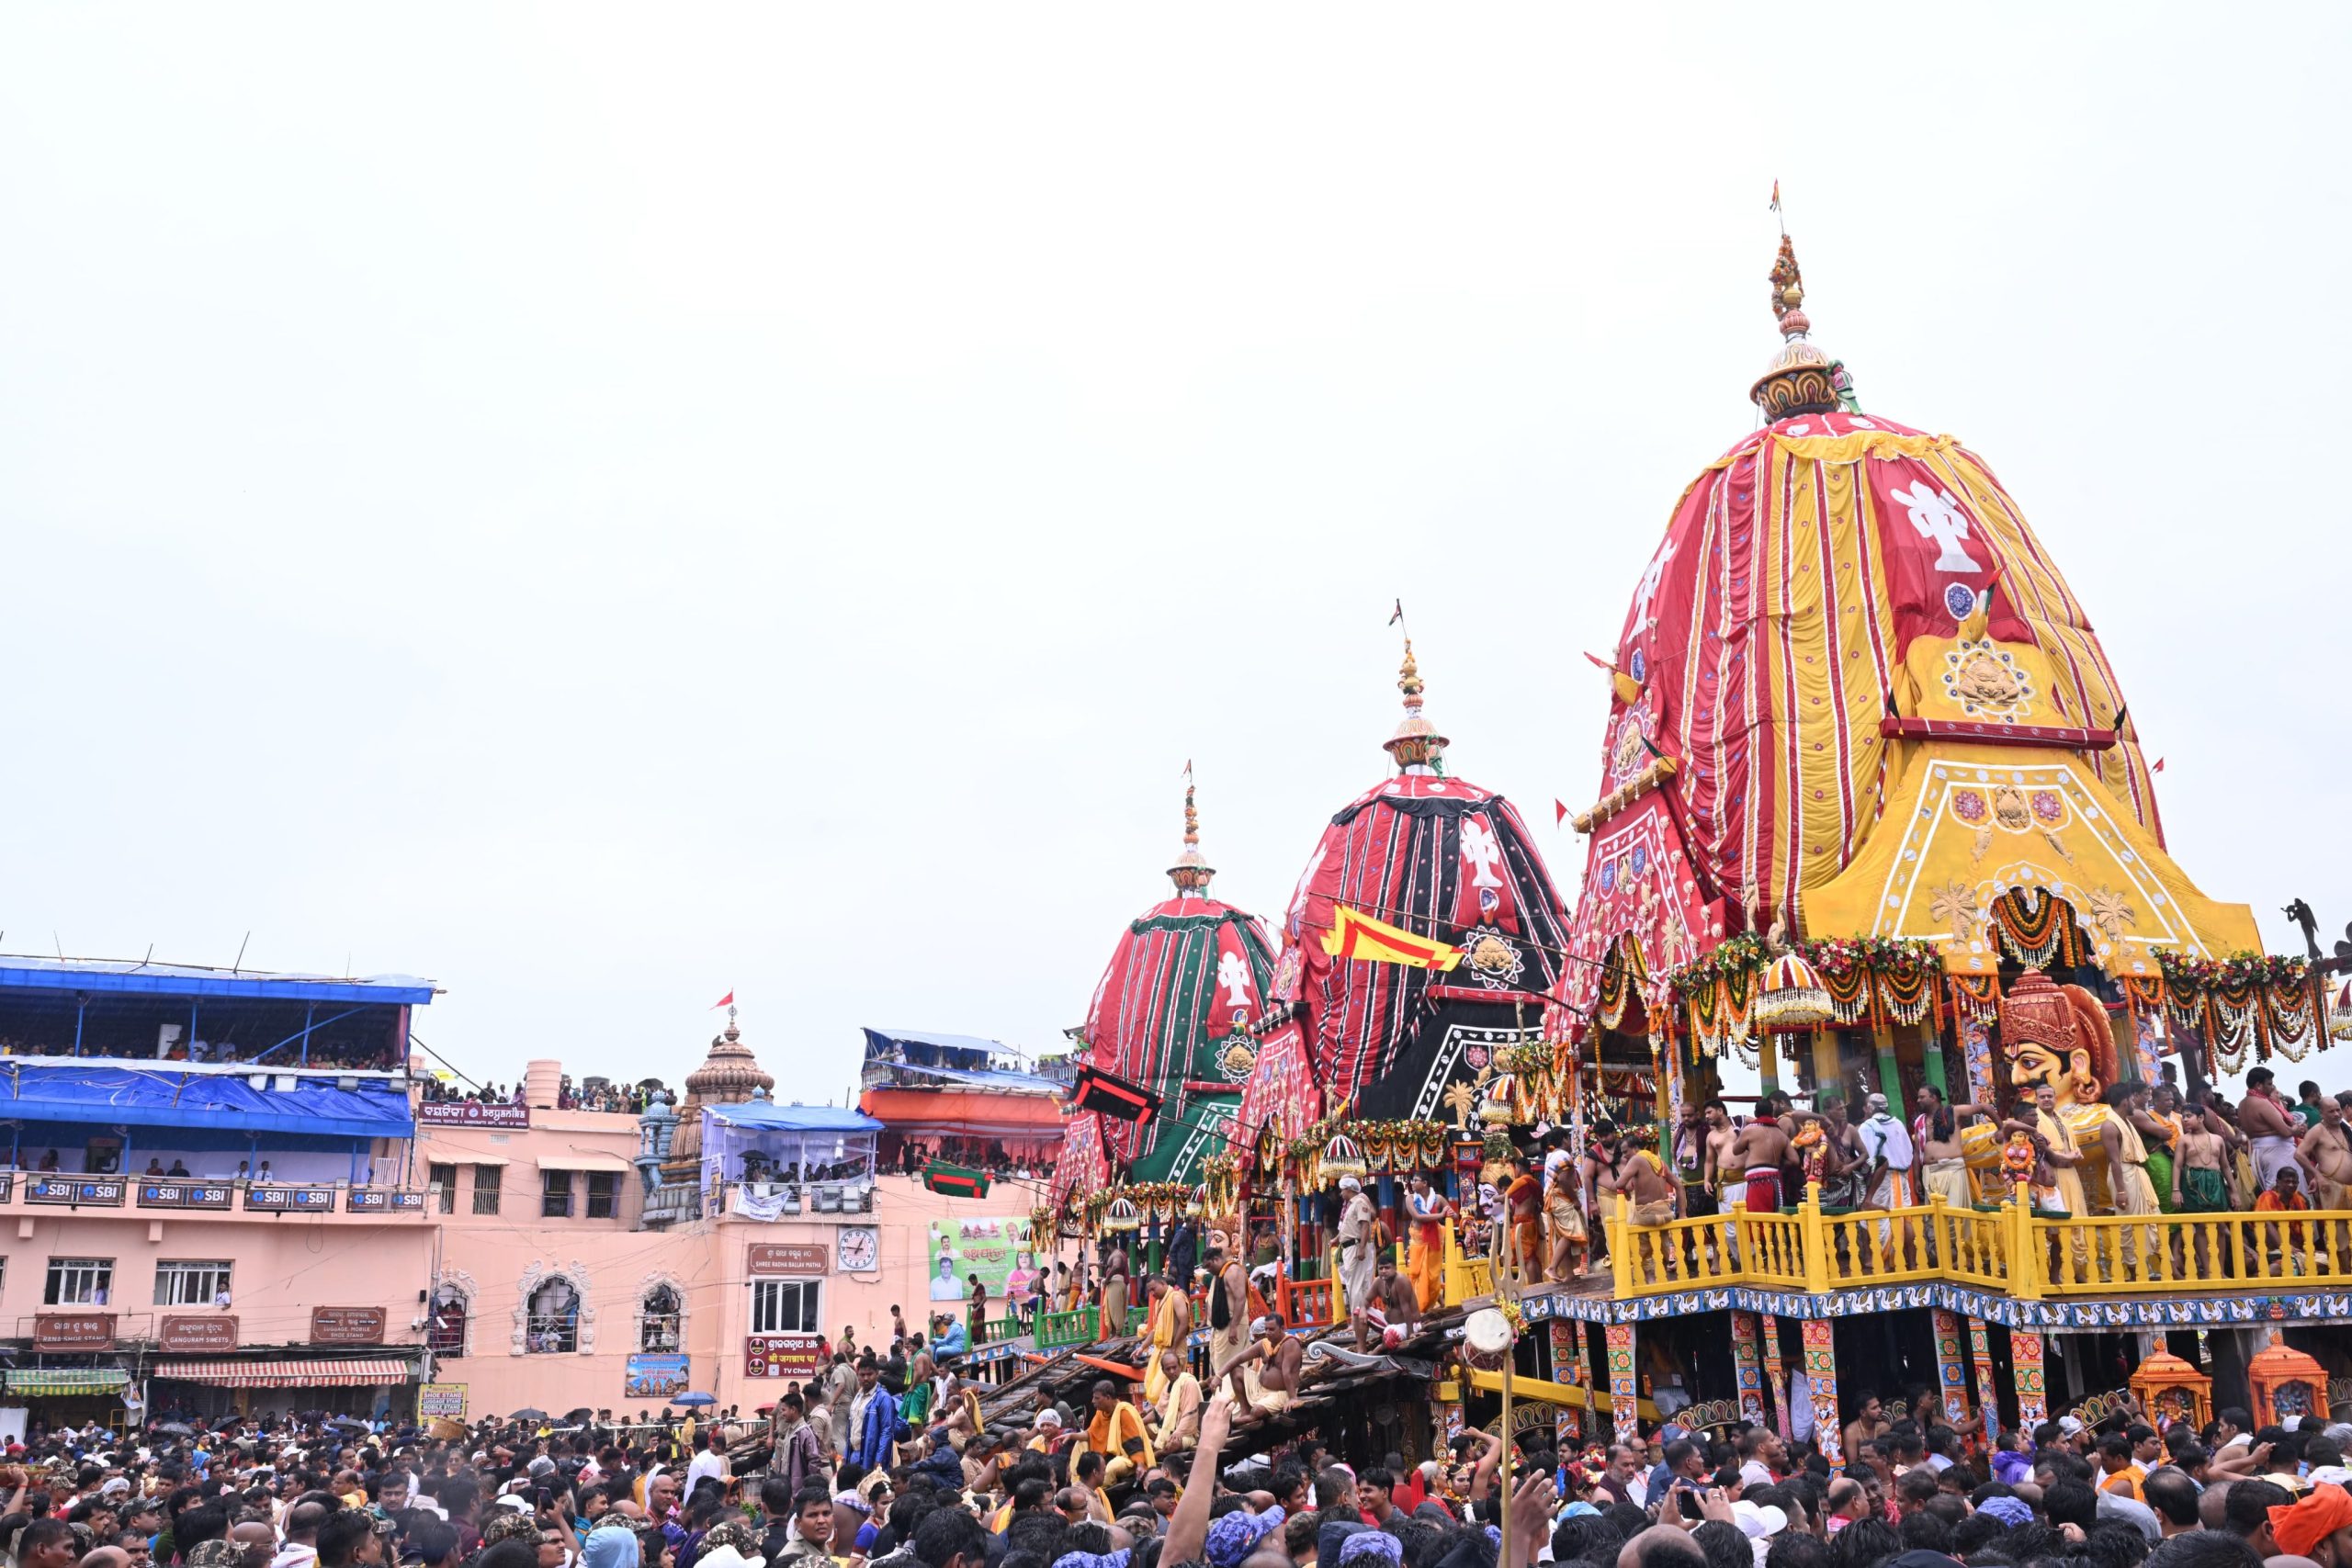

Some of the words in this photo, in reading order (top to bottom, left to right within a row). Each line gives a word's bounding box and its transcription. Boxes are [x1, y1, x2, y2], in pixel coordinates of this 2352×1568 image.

[482, 1105, 526, 1121] boyanika
[48, 1183, 70, 1196] SBI
[96, 1186, 118, 1198] SBI
[158, 1188, 179, 1200] SBI
[204, 1190, 225, 1201] SBI
[265, 1191, 285, 1202] SBI
[308, 1192, 328, 1203] SBI
[365, 1194, 383, 1204] SBI
[403, 1194, 422, 1205] SBI
[807, 1339, 818, 1348] ଧା
[768, 1352, 777, 1363] श्री
